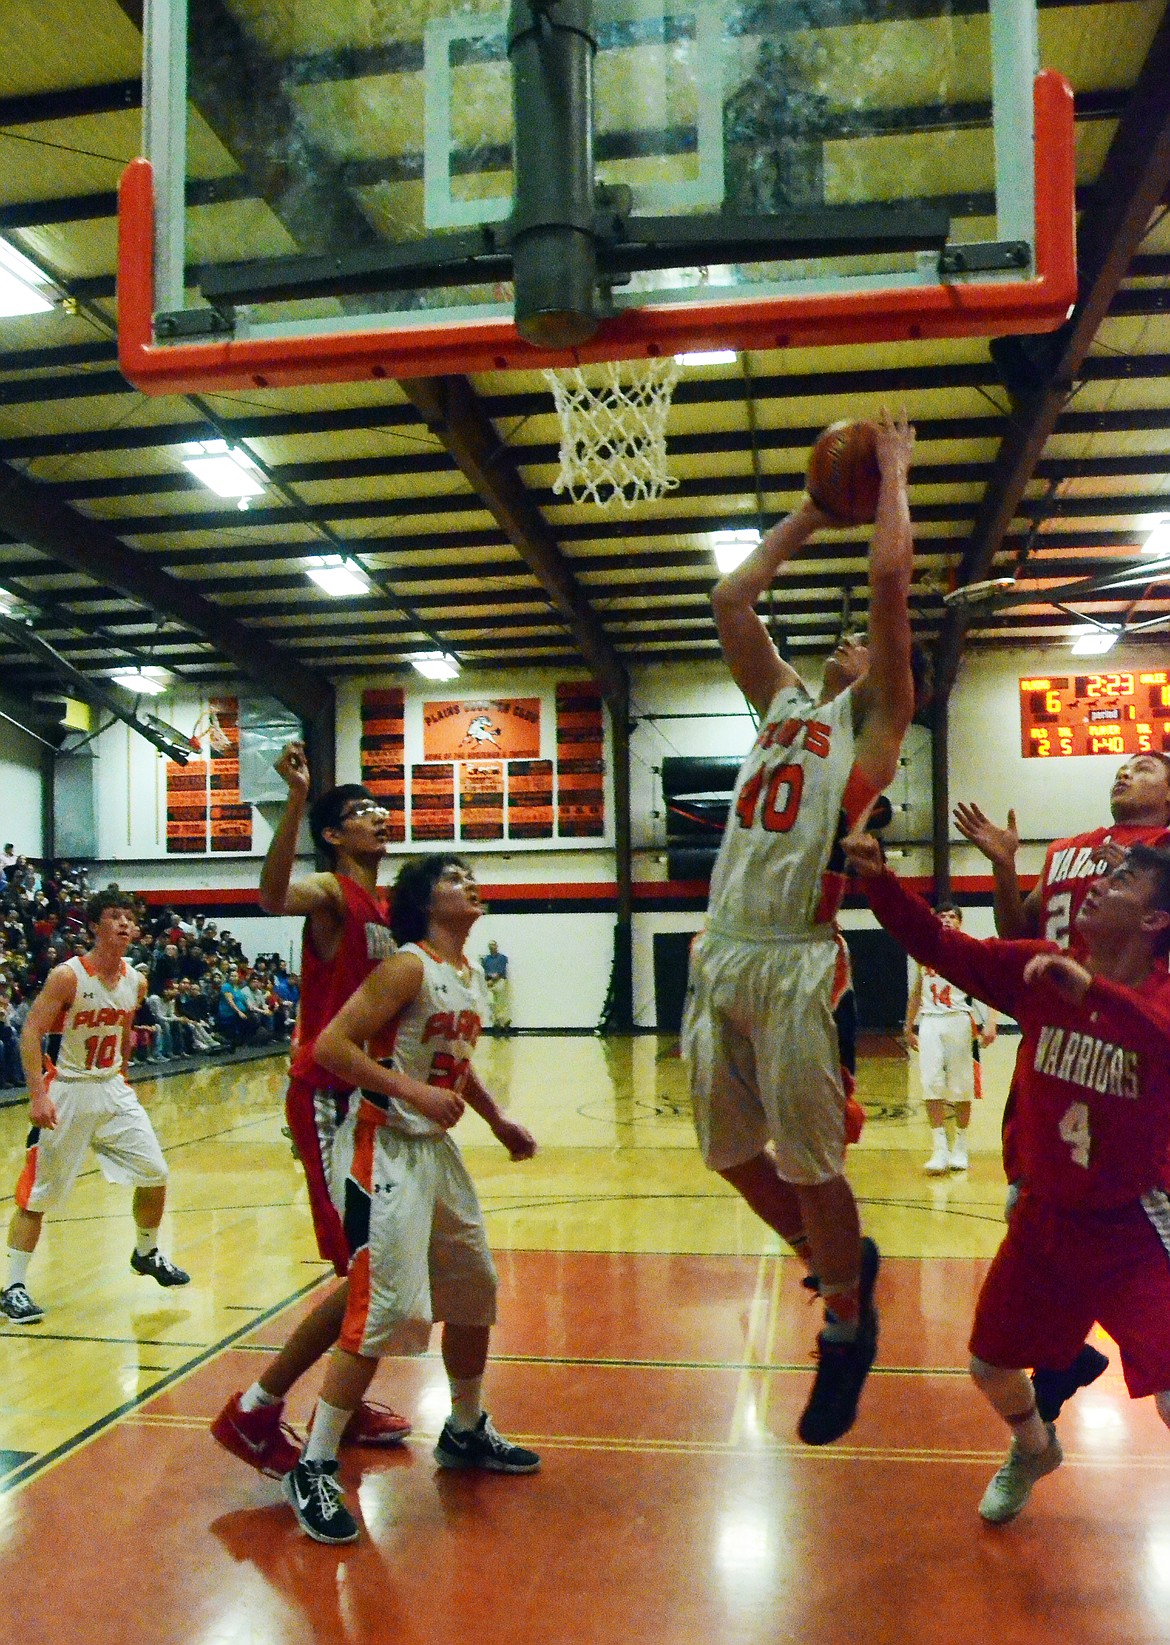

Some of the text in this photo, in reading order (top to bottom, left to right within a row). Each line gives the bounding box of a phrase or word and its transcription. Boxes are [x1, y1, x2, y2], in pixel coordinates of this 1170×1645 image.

[1087, 673, 1135, 697] 2:23
[1045, 691, 1062, 713] 6
[1091, 705, 1136, 721] period 1
[1038, 740, 1051, 756] 2
[1060, 738, 1073, 755] 5
[1139, 735, 1151, 752] 5
[736, 761, 804, 833] 40
[929, 983, 952, 1009] 14
[85, 1035, 117, 1069] 10
[1058, 1101, 1092, 1169] 4
